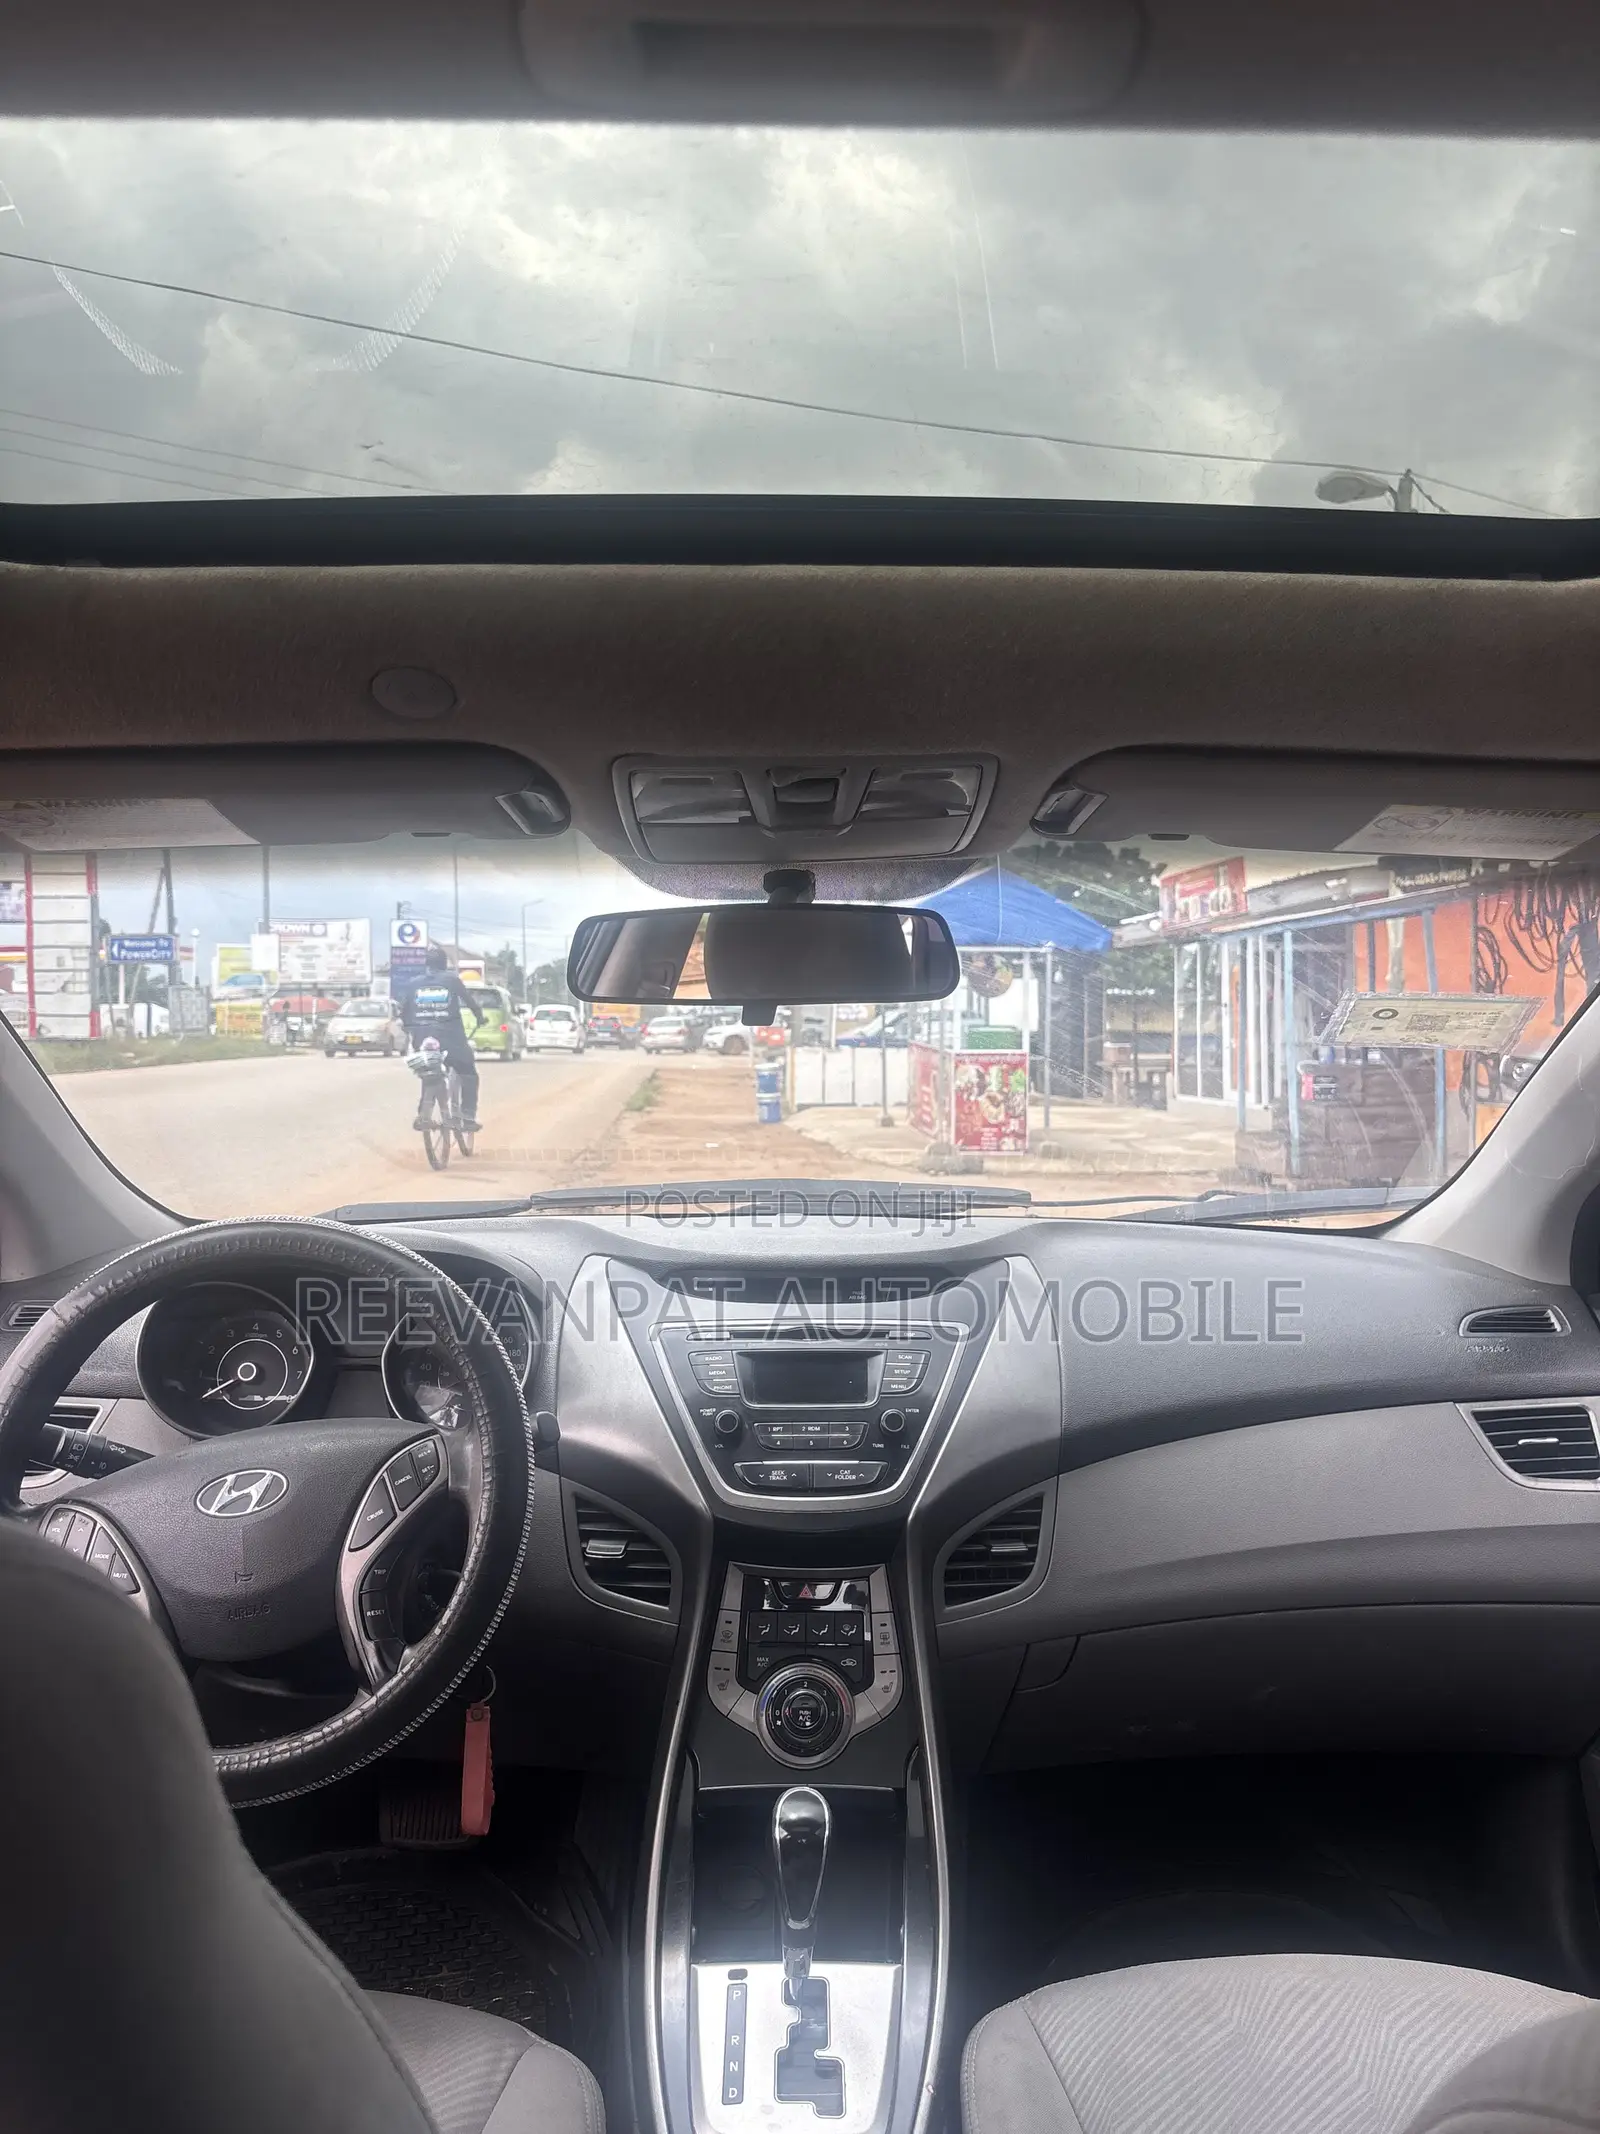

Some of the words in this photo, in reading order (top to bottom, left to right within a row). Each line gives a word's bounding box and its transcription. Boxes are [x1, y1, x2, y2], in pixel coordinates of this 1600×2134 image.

[252, 1323, 259, 1331] 4
[276, 1329, 283, 1339] 5
[292, 1346, 299, 1355] 6
[509, 1349, 522, 1357] 180
[297, 1371, 303, 1379] 7
[394, 1474, 412, 1486] CANCEL
[366, 1508, 385, 1522] CRUISE
[373, 1568, 387, 1576] TRIP
[366, 1608, 386, 1617] RESET
[733, 1990, 742, 2000] P
[731, 2035, 740, 2046] R
[729, 2061, 738, 2072] N
[728, 2087, 738, 2098] D
